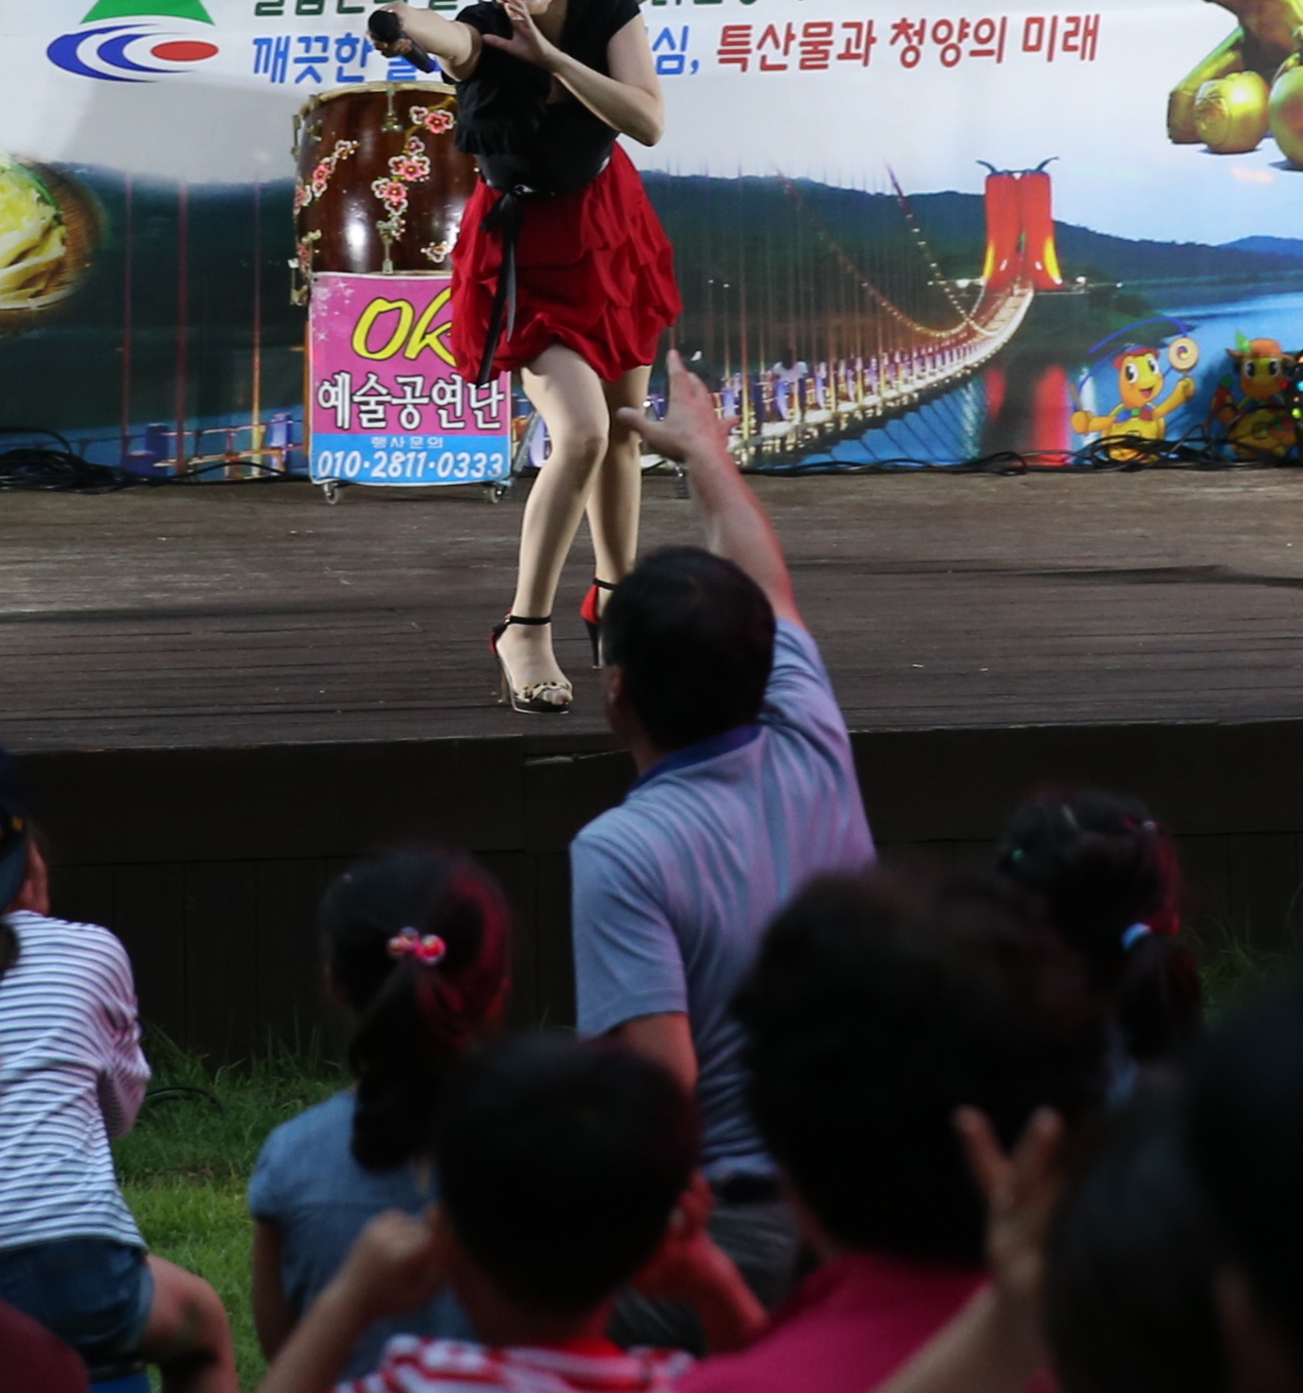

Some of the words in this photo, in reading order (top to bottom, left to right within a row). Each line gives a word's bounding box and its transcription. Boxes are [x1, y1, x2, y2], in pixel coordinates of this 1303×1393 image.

[252, 31, 375, 84] 깨끗한
[716, 18, 877, 74] 특산물과
[889, 15, 1008, 69] 청양의
[1021, 13, 1101, 63] 미래
